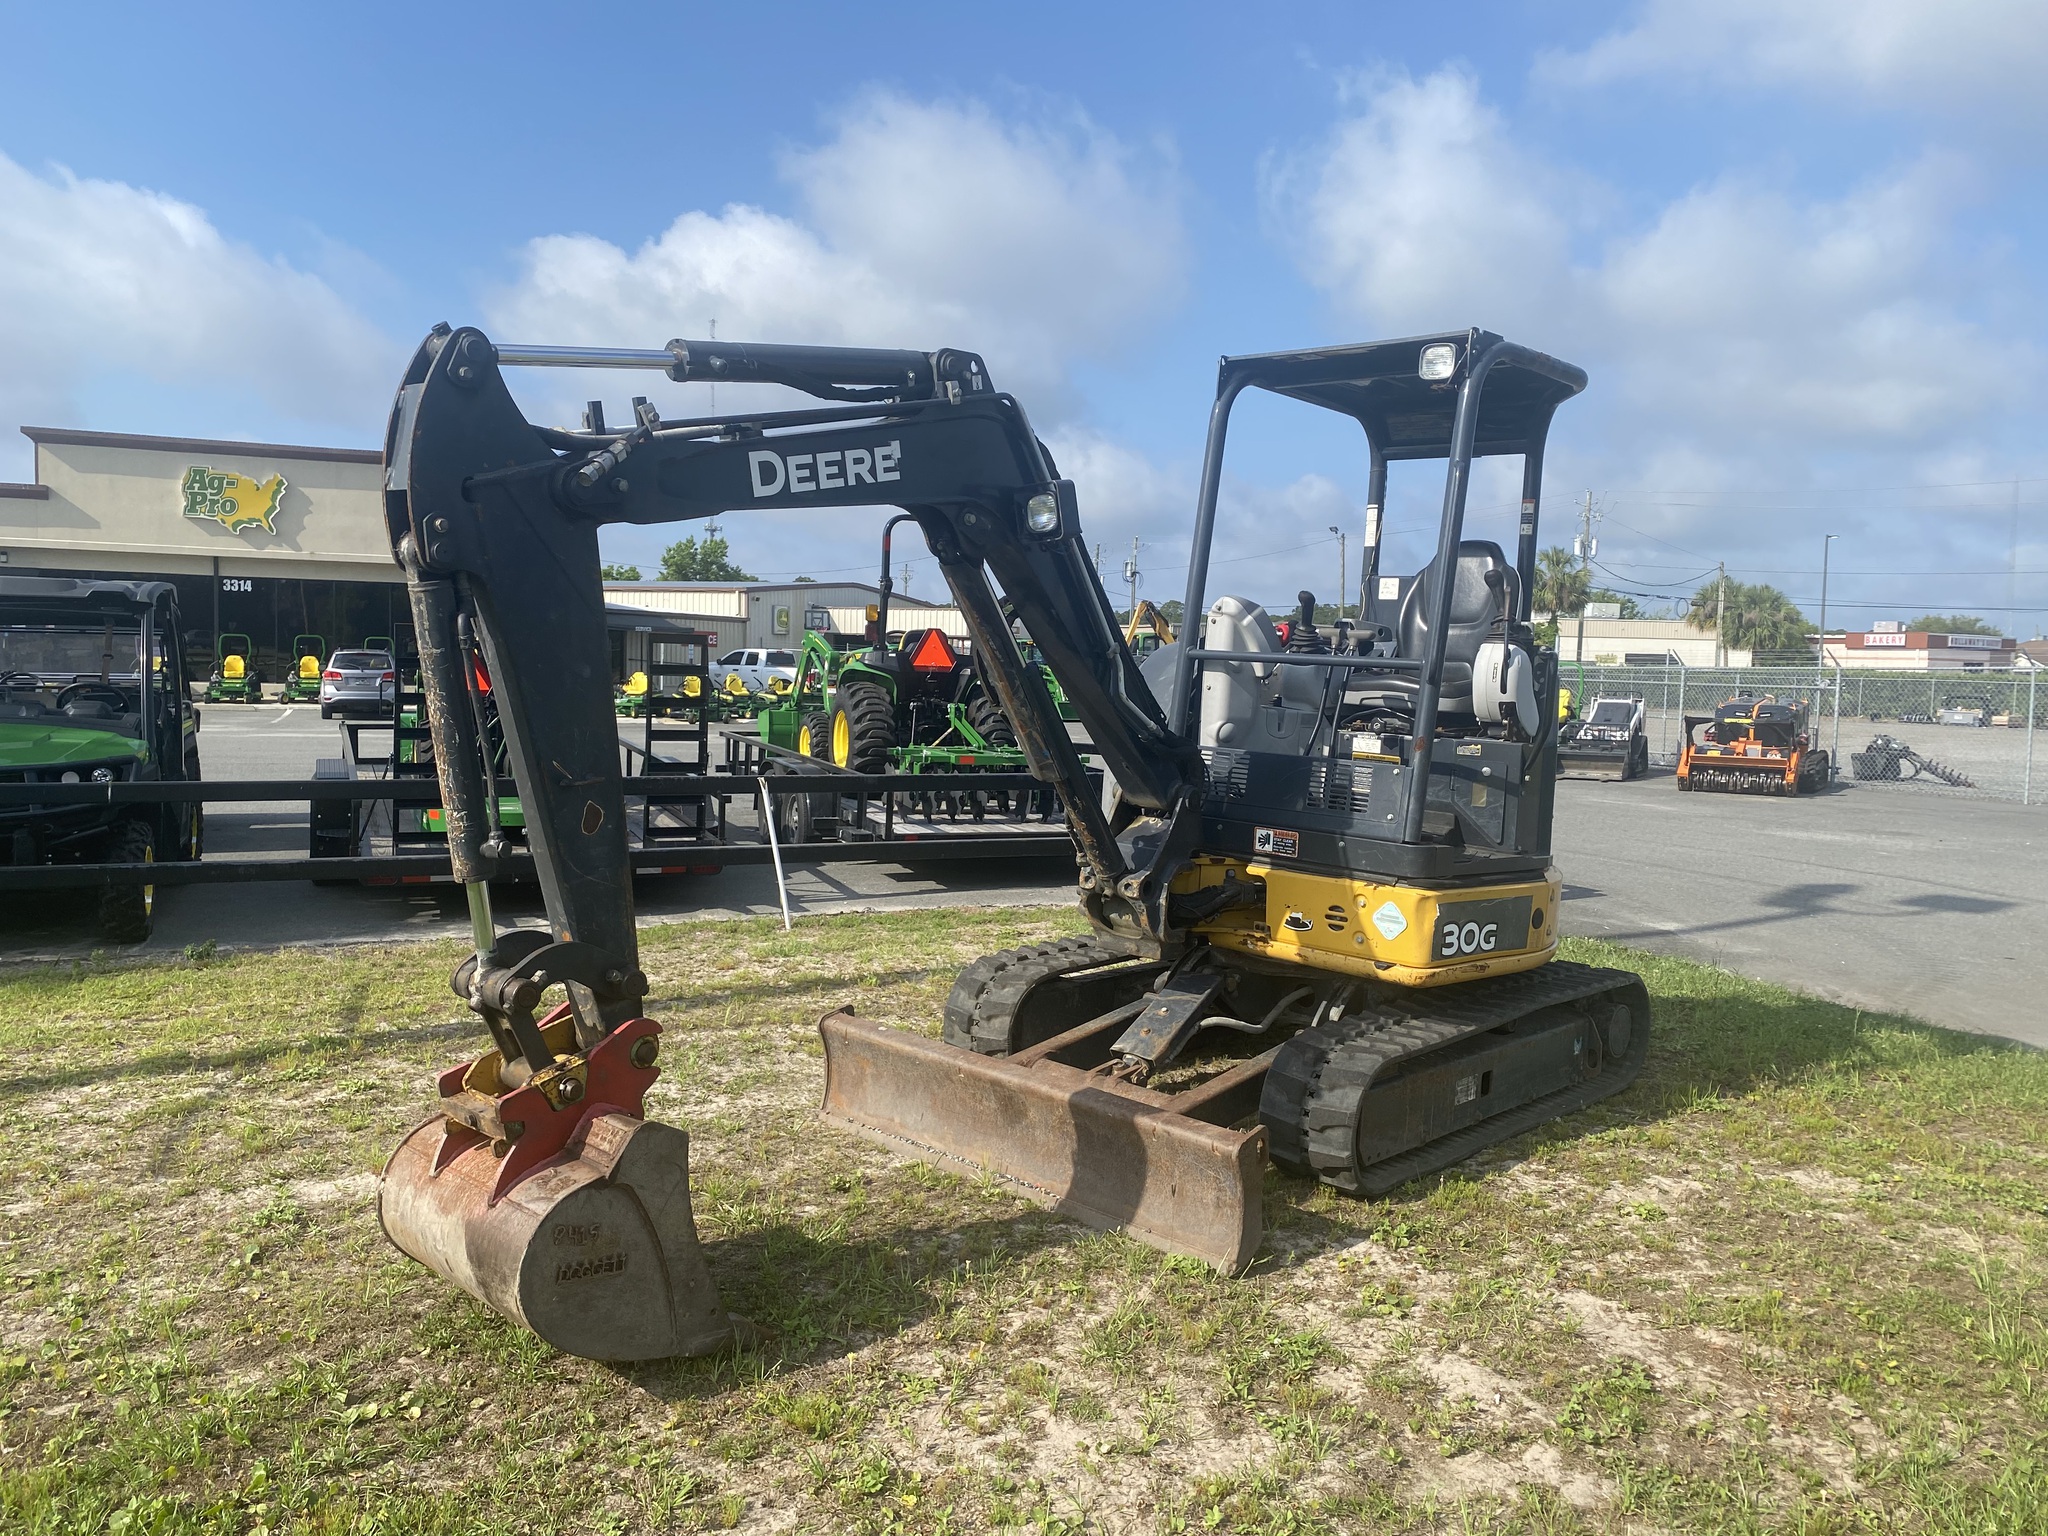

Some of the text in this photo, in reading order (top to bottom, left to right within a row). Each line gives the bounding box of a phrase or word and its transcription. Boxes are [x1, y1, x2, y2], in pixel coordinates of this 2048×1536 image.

[184, 466, 239, 498] Ag-
[748, 440, 901, 498] DEERE
[184, 490, 239, 517] Pro
[223, 579, 252, 592] 3314
[1865, 636, 1904, 645] BAKERY
[1441, 921, 1498, 956] 30G
